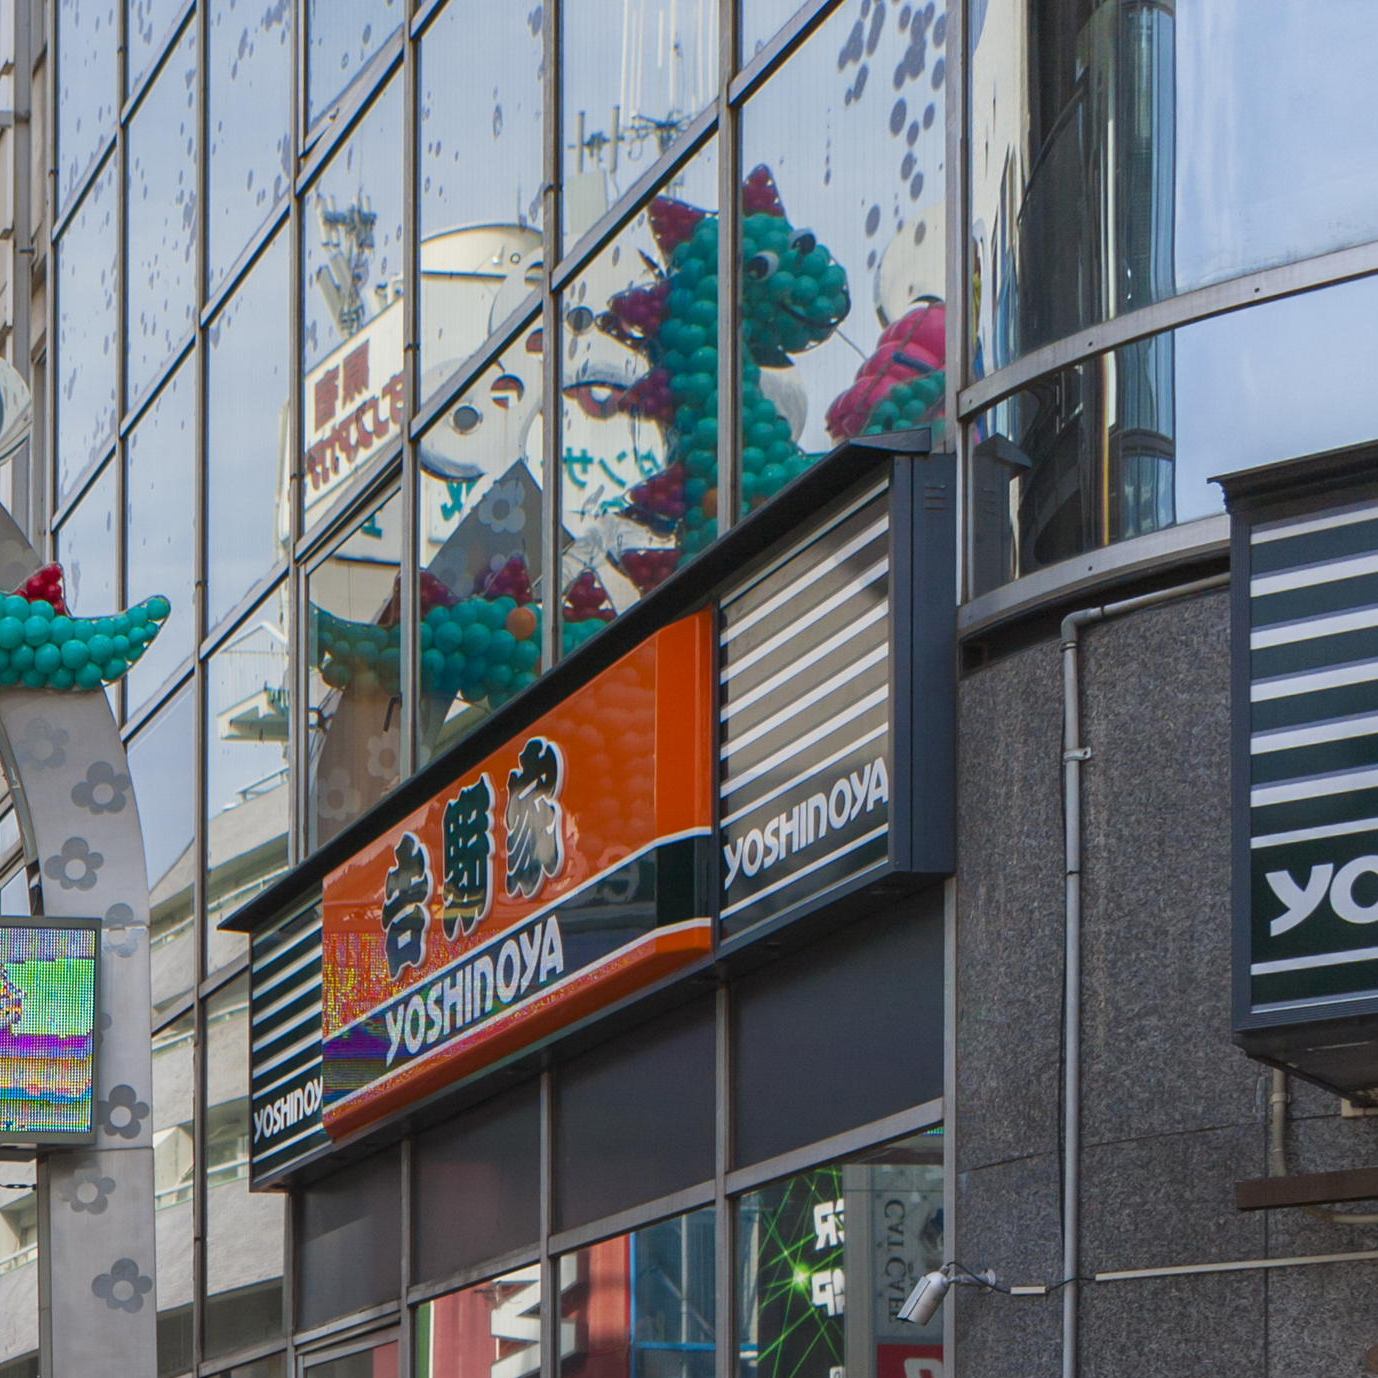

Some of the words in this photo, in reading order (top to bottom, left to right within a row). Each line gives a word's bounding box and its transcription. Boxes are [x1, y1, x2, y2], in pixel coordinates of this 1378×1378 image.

[382, 736, 564, 982] 吉野家
[722, 756, 889, 891] YOSHINOYA
[385, 915, 564, 1069] YOSHINOYA
